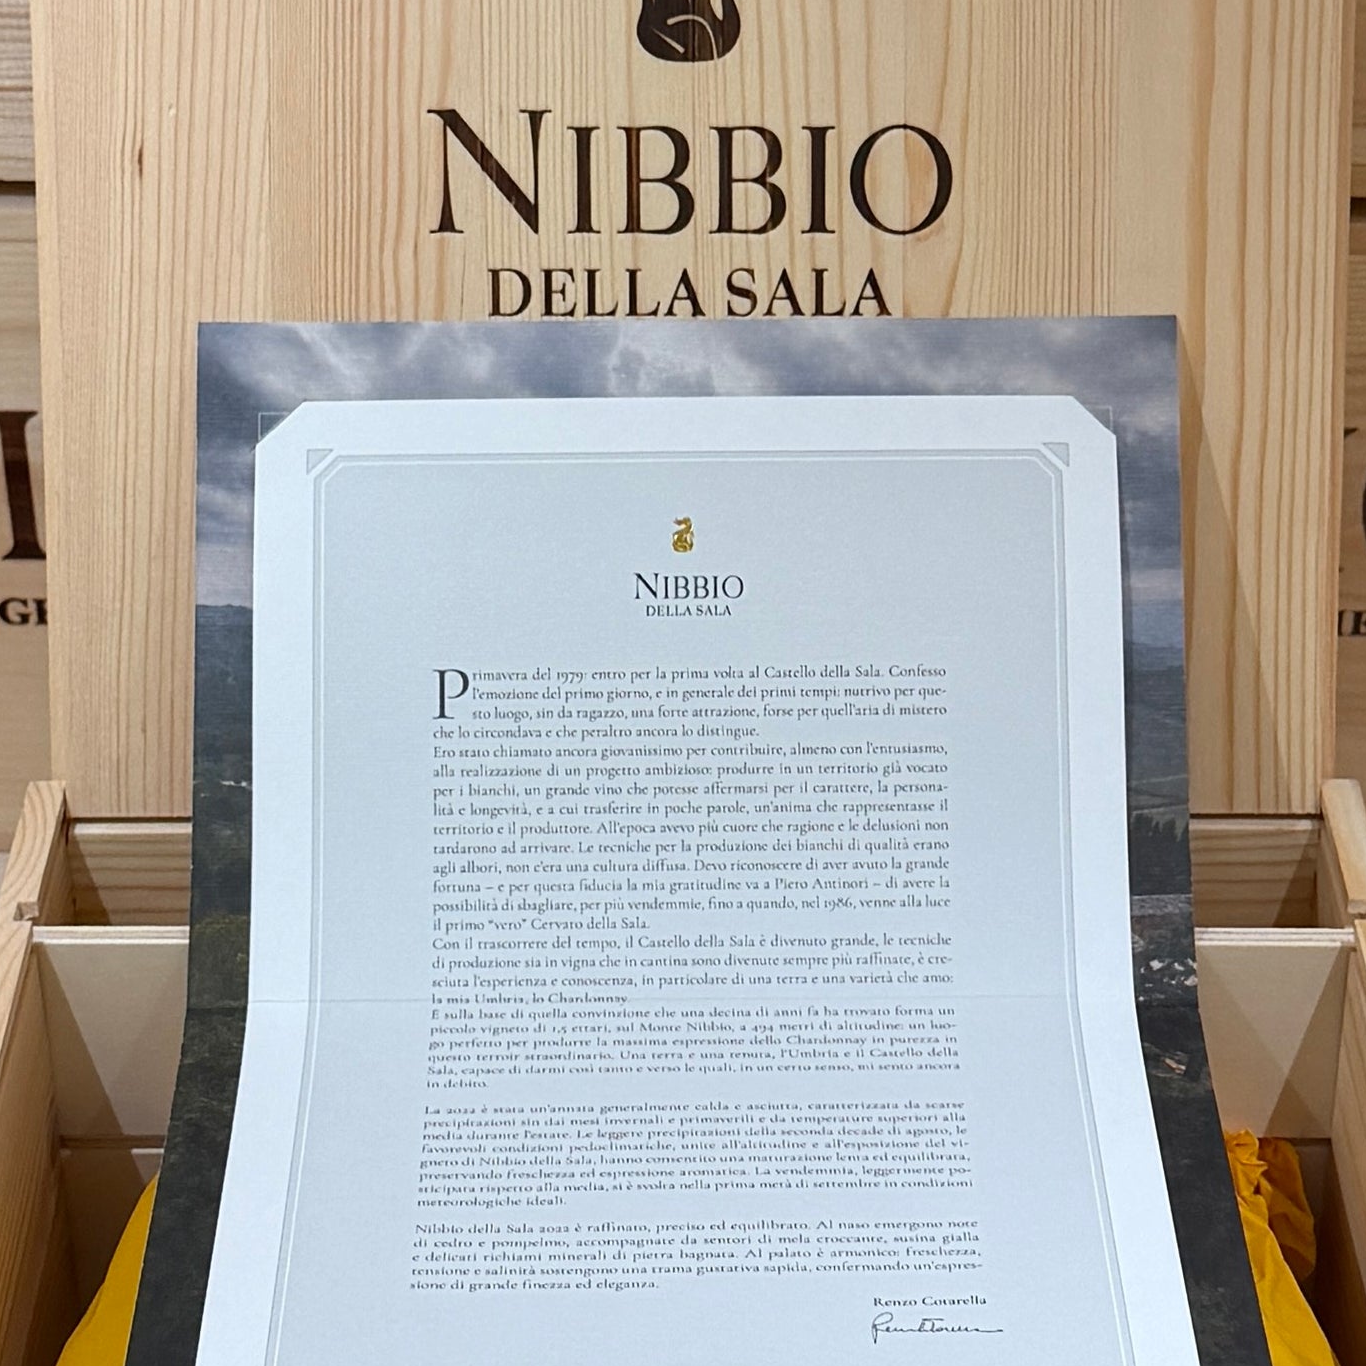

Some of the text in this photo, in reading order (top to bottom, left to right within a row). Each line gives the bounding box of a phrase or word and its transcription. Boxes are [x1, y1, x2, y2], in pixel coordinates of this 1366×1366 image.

[487, 268, 894, 319] DELLA SALA
[645, 604, 732, 617] DELLA SALA
[531, 666, 551, 681] del
[591, 670, 627, 681] entro
[630, 671, 651, 684] per
[655, 666, 667, 680] la
[671, 667, 709, 684] prima
[713, 665, 744, 679] volta
[748, 664, 760, 679] al
[764, 664, 816, 679] Castello
[819, 664, 851, 678] della
[855, 663, 884, 678] Sala.
[888, 663, 947, 677] Confesso
[873, 1296, 917, 1307] Renzo
